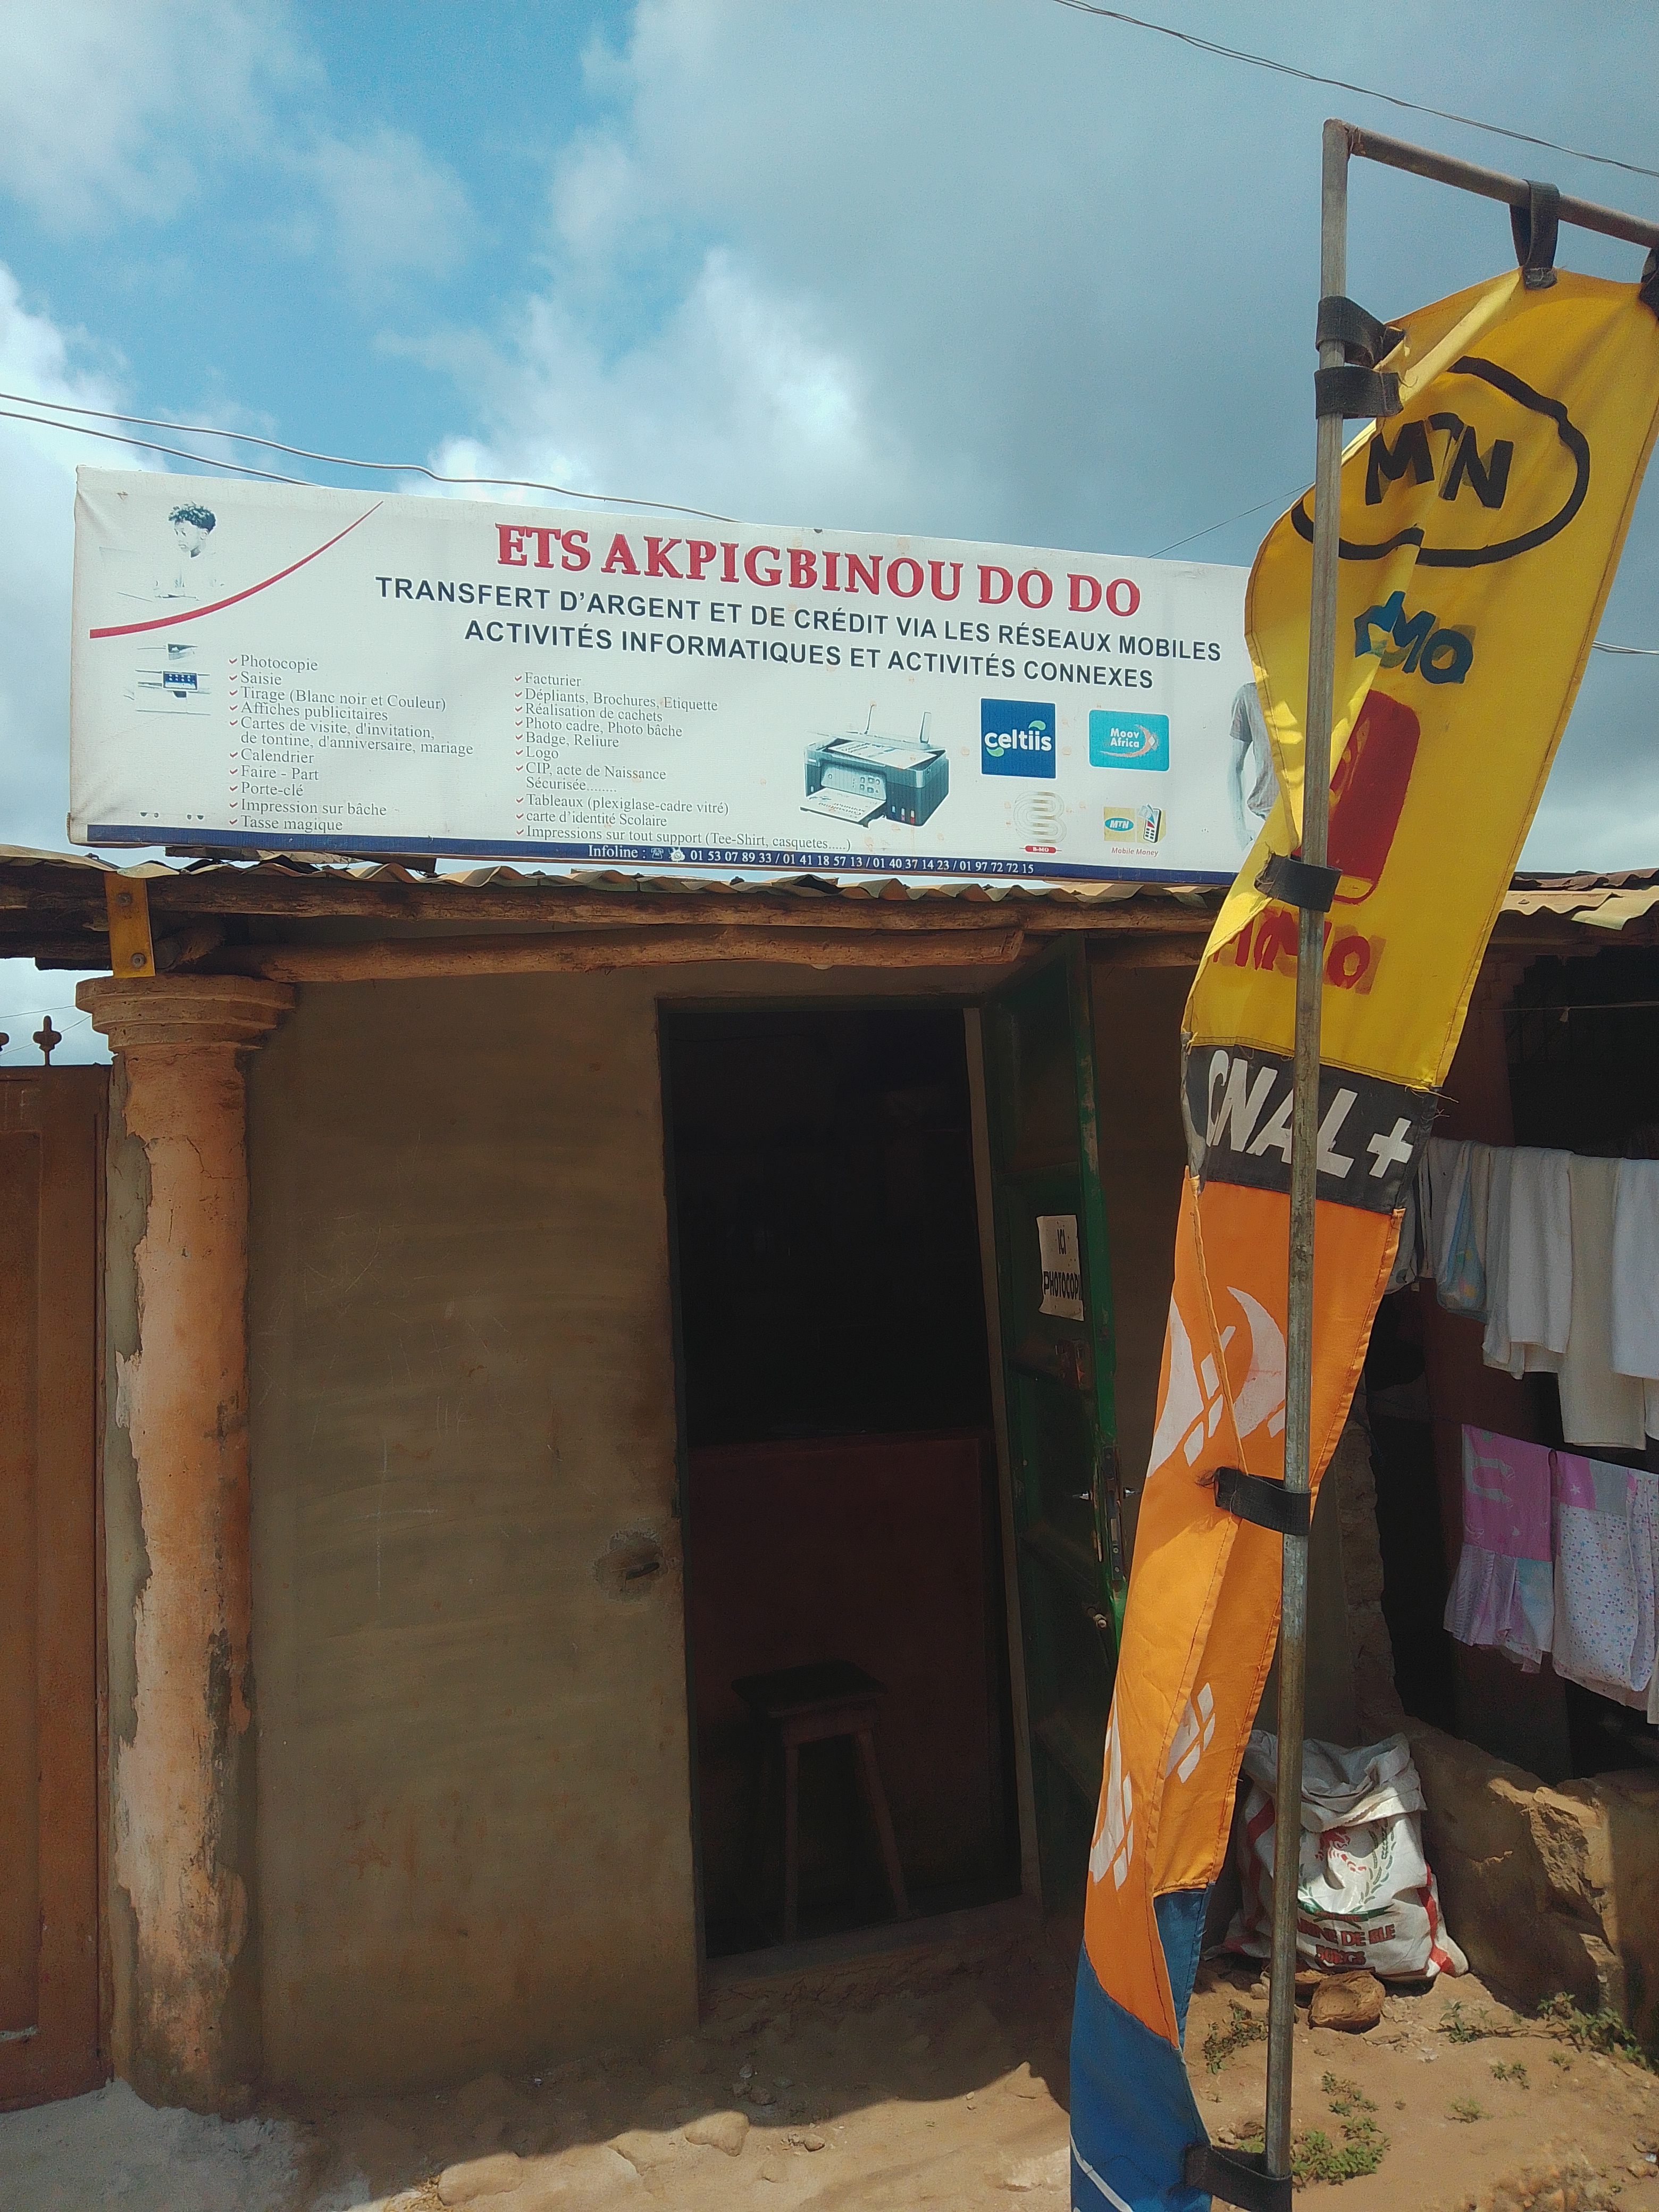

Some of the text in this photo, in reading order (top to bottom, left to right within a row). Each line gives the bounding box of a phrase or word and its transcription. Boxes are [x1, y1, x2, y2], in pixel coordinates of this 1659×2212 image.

[495, 522, 1141, 617] ETS AKPIGBINOU DO DO
[375, 576, 550, 609] TRANSFERT
[710, 602, 742, 623] ET
[751, 605, 785, 627] DE
[794, 607, 889, 636] CRÉDIT
[896, 617, 936, 639] VIA
[945, 621, 990, 644] LES
[999, 621, 1111, 653] RÉSEAUX
[1119, 635, 1221, 661] MOBILES
[240, 654, 319, 673] Photocopie
[465, 620, 1153, 689] ACTIVITÉS INFORMATIQUES ET ACTIVITÉS CONNEXES
[240, 672, 282, 685] Saisie
[524, 672, 582, 686] Facturier
[241, 686, 446, 712] Tirage (Blanc noir et Couleur)
[525, 689, 718, 711] Dépliants, Brochures, Etiquette
[241, 702, 388, 721] Affiches publicitaires
[525, 703, 663, 722] Réalisation de cachets
[241, 717, 434, 740] Cartes de visite, d'invitation,
[525, 717, 682, 737] Photo cadre, Photo bâche
[1110, 727, 1139, 738] Moov
[241, 732, 473, 757] de tontine, d'anniversaire, mariage
[526, 732, 619, 748] Badge, Reliure
[984, 729, 1052, 751] celtiis
[1110, 737, 1139, 748] Africa
[241, 749, 315, 763] Calendrier
[526, 747, 559, 761] Logo
[241, 765, 276, 778] Faire
[292, 767, 319, 780] Part
[526, 762, 667, 780] CIP, acte de Naissance
[241, 782, 304, 797] Porte-clé
[241, 799, 387, 816] Impression sur bâche
[526, 794, 729, 816] Tableaux (plexiglase-cadre vitré)
[241, 816, 343, 833] Tasse magique
[526, 812, 556, 823] carte
[619, 815, 667, 826] Scolaire
[1110, 820, 1129, 829] MTN
[527, 825, 602, 840] Impressions
[606, 830, 625, 840] sur
[629, 830, 653, 841] tout
[657, 832, 702, 846] support
[706, 832, 769, 848] (Tee-Shirt,
[589, 845, 638, 858] Infoline
[691, 850, 703, 861] 01
[708, 851, 720, 861] 53
[725, 851, 738, 862] 07
[742, 852, 755, 862] 89
[758, 852, 772, 863] 33
[783, 853, 794, 864] 01
[800, 854, 812, 865] 41
[818, 855, 830, 866] 18
[833, 856, 846, 866] 57
[851, 857, 862, 867] 13
[873, 857, 884, 868] 01
[889, 858, 902, 869] 40
[905, 858, 918, 869] 37
[922, 859, 934, 870] 14
[937, 859, 949, 870] 23
[960, 860, 971, 872] 01
[975, 861, 987, 872] 97
[991, 861, 1003, 873] 72
[1007, 862, 1018, 873] 72
[1022, 863, 1034, 874] 15
[1136, 848, 1159, 857] Money
